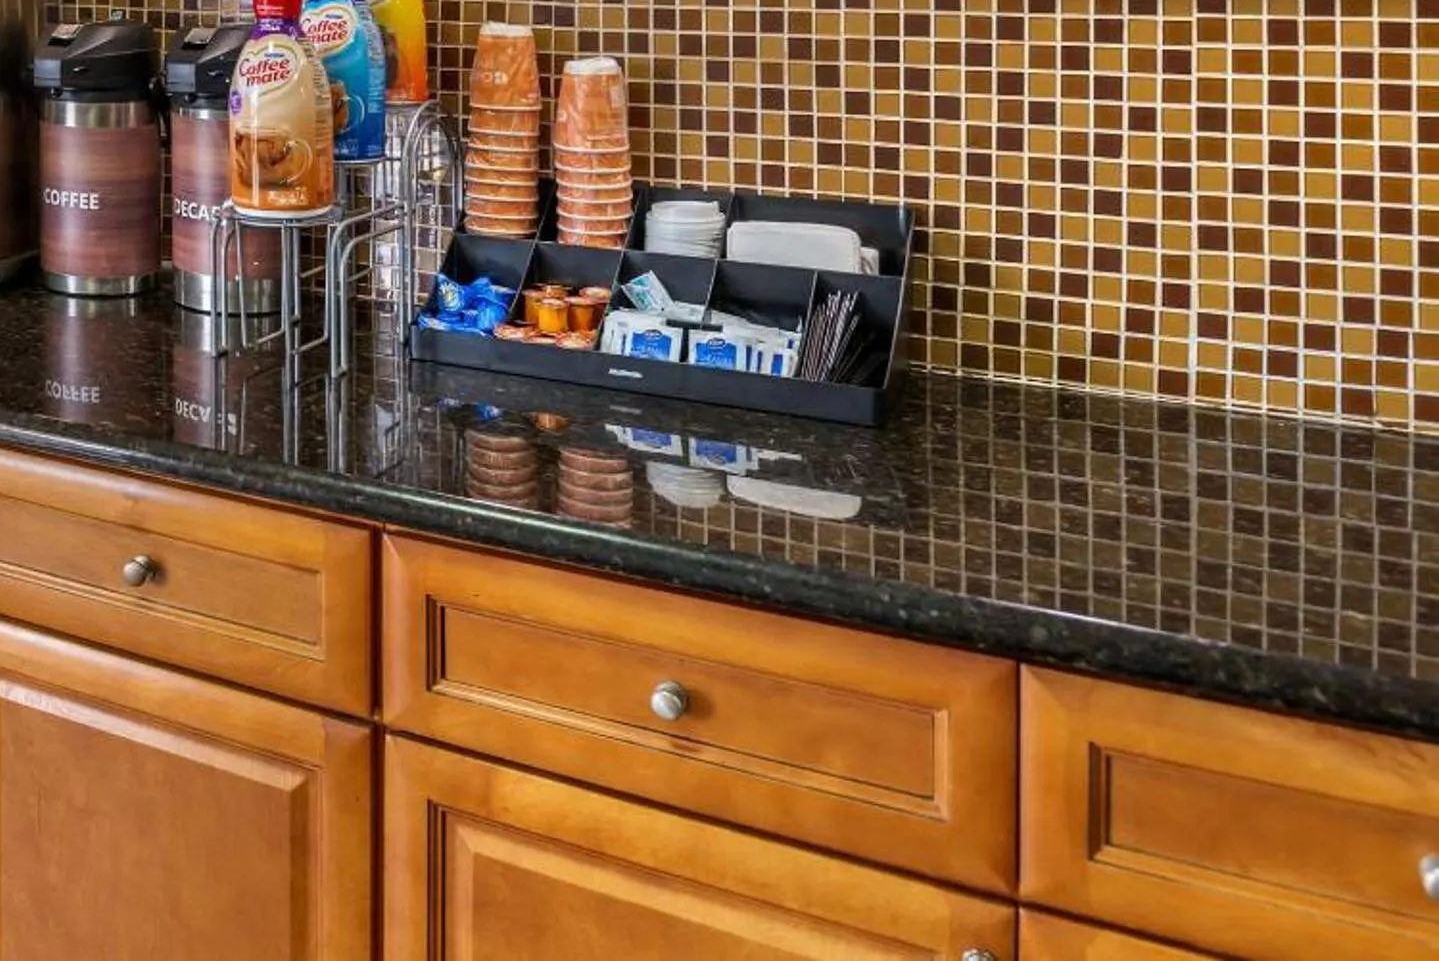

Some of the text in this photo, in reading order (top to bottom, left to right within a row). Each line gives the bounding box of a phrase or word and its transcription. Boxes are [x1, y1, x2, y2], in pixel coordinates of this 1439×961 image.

[239, 58, 290, 77] Coffee
[246, 70, 290, 87] mate
[44, 188, 100, 210] COFFEE
